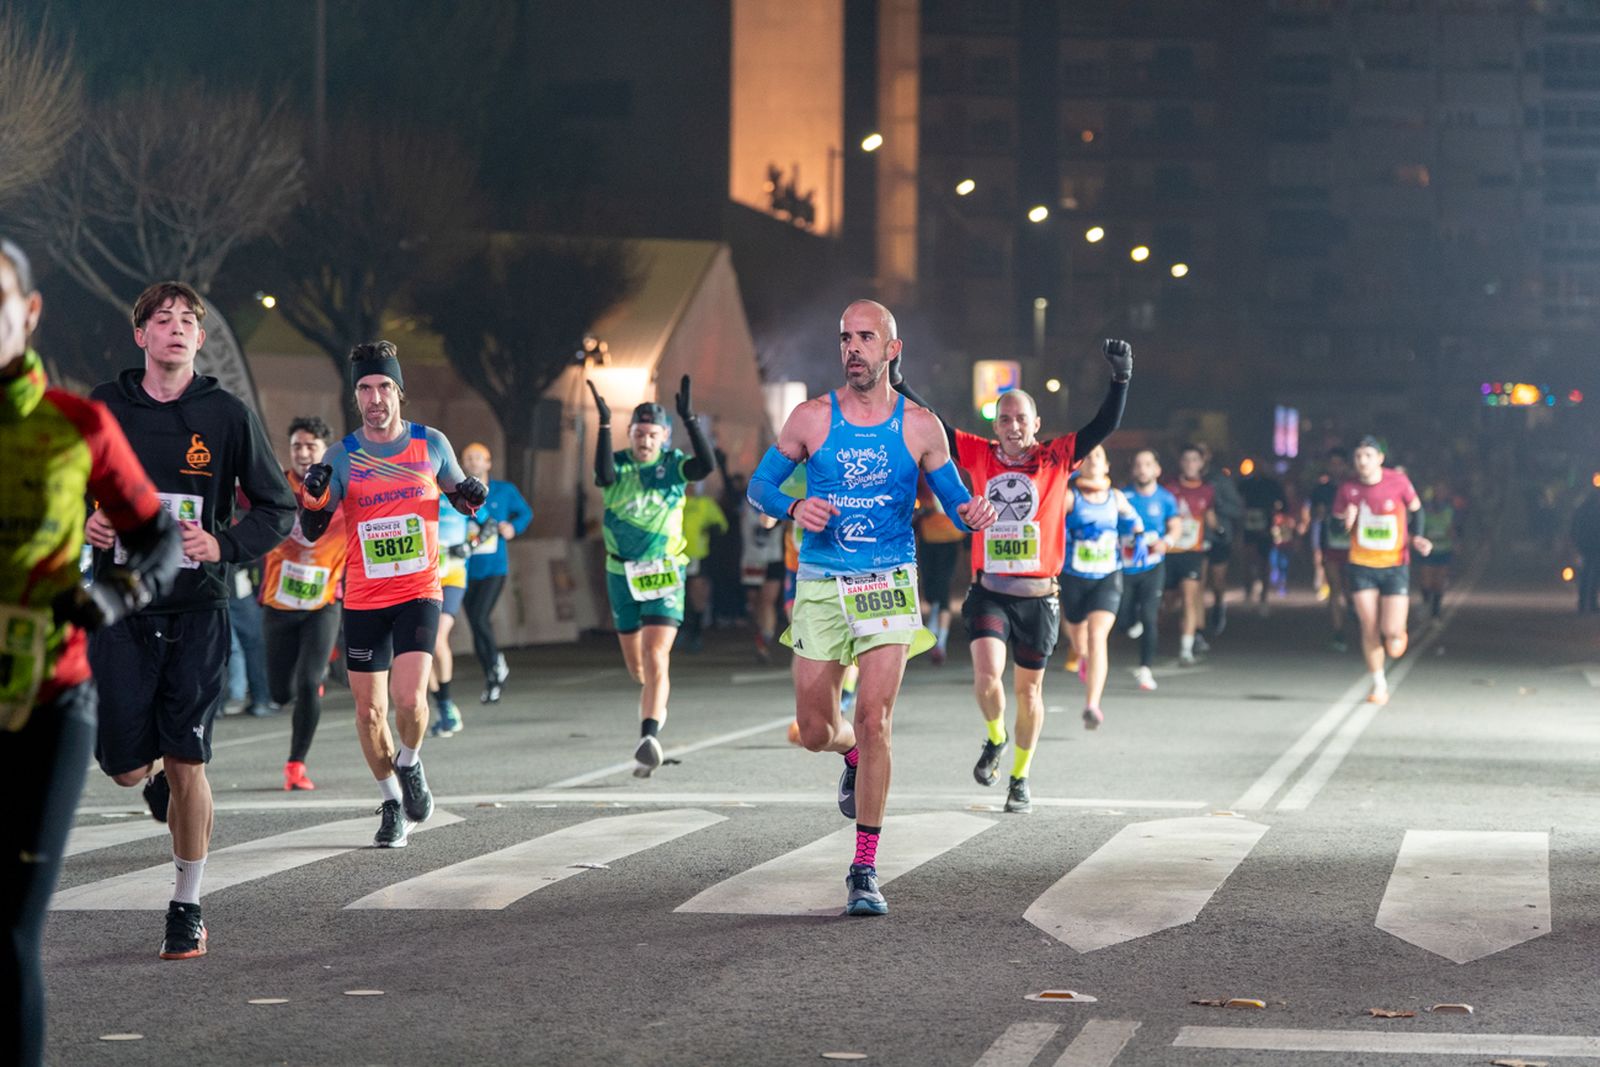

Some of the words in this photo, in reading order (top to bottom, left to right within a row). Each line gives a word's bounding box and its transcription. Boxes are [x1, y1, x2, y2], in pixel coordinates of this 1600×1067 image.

[843, 457, 868, 479] 25
[374, 536, 414, 557] 5812
[995, 540, 1028, 555] 5401
[847, 585, 863, 594] SAN
[855, 589, 907, 613] 8699
